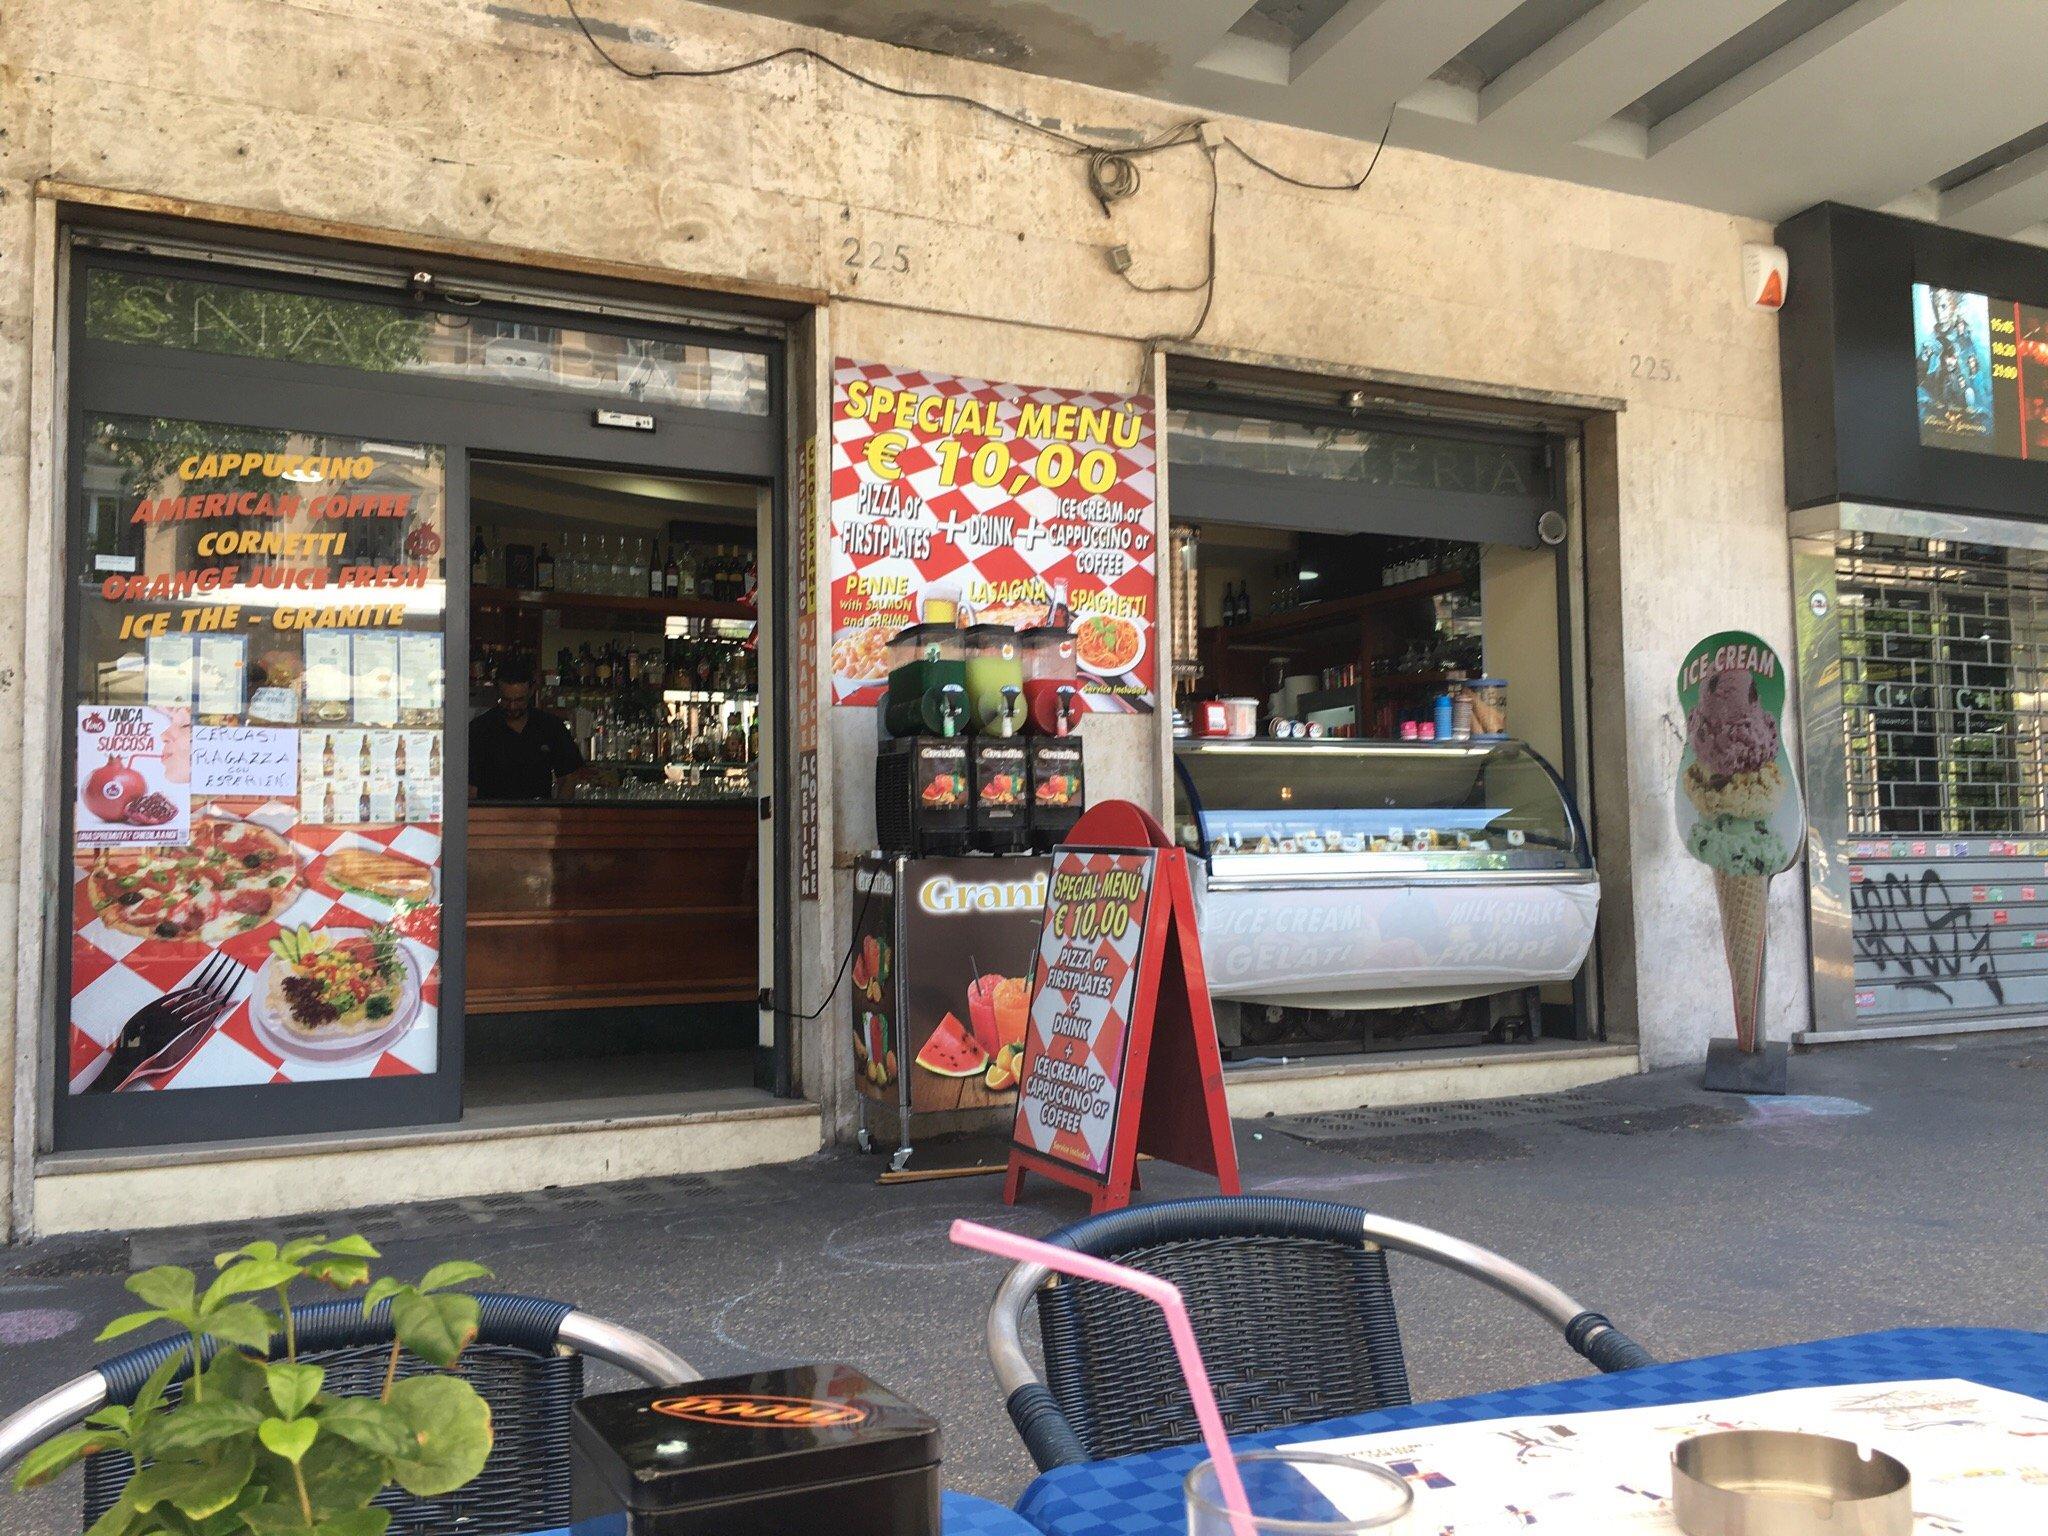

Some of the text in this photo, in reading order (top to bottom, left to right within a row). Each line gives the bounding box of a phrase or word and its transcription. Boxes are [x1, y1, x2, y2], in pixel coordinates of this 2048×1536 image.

[842, 237, 910, 273] 225
[1631, 354, 1672, 381] 225
[844, 379, 1142, 448] SPECIAL MENÙ
[179, 452, 374, 481] CAPPUCCINO
[862, 431, 1118, 495] € 10,00
[130, 491, 414, 523] AMERICAN COFFEE
[856, 482, 922, 520] PIZZA or
[1054, 497, 1143, 525] ICE CREAM or
[197, 530, 347, 558] CORNETTI
[841, 520, 931, 561] FIRSTPLATES
[969, 514, 1015, 547] DRINK
[1050, 524, 1149, 551] CAPPUCCINO or
[1076, 551, 1124, 576] COFFEE
[102, 564, 429, 600] ORANGE JUICE FRESH
[845, 575, 909, 597] PENNE
[966, 578, 1048, 605] LASAGNA
[840, 599, 912, 612] with SALMON
[1070, 589, 1147, 617] SPAGHETTI
[119, 610, 168, 641] ICE
[181, 605, 241, 633] THE
[272, 604, 406, 630] GRANITE
[843, 613, 909, 627] and SHRIMP
[1683, 645, 1775, 692] ICE CREAM
[108, 708, 143, 722] UNICA
[115, 722, 153, 736] DOLCE
[97, 736, 154, 752] SUCCOSA
[194, 749, 290, 765] RAGAZZA
[800, 755, 809, 896] AMERICAN
[808, 755, 817, 894] COFFEE
[921, 872, 1048, 912] Grani
[1054, 873, 1098, 900] SPECIAL
[1054, 901, 1129, 941] € 10,00
[1223, 905, 1362, 935] ICE CREAM
[1060, 947, 1108, 972] PIZZA or
[1226, 944, 1354, 975] GELATI
[1046, 967, 1113, 996] FIRSTPLATES
[1053, 1014, 1091, 1040] DRINK
[1034, 1055, 1105, 1092] ICE CREAM or
[1026, 1076, 1109, 1119] CAPPUCCINO or
[1040, 1104, 1082, 1133] COFFEE
